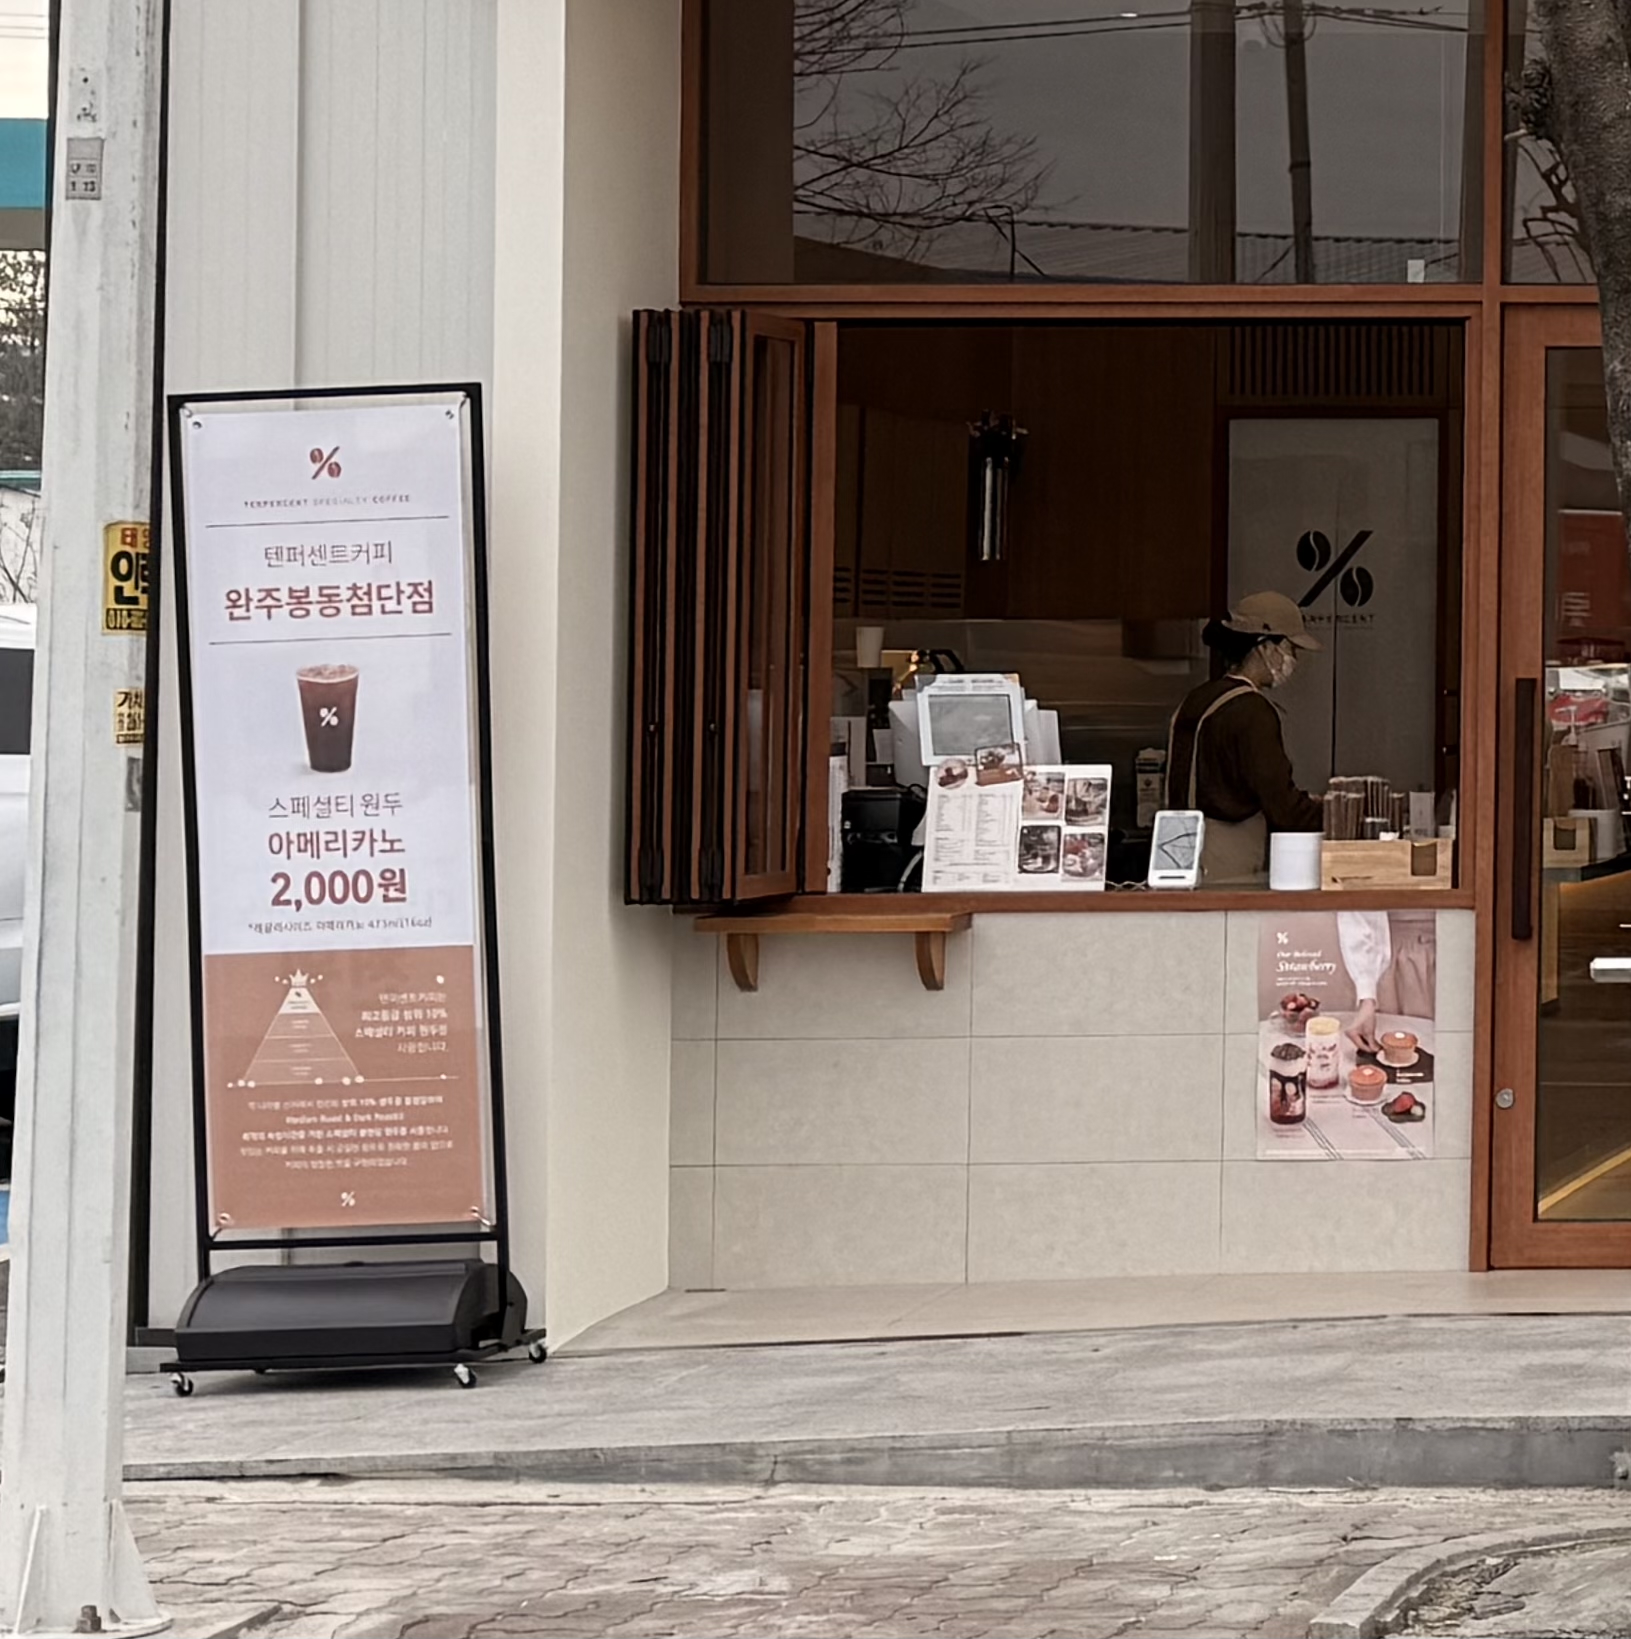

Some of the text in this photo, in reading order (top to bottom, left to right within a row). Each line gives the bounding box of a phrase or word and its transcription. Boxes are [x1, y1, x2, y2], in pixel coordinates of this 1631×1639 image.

[263, 539, 394, 569] 텐퍼센트커피
[224, 579, 435, 622] 완주봉동첨단점
[267, 792, 404, 820] 스페셜티 원두
[268, 828, 407, 860] 아메리카노
[270, 867, 409, 911] 2,000원
